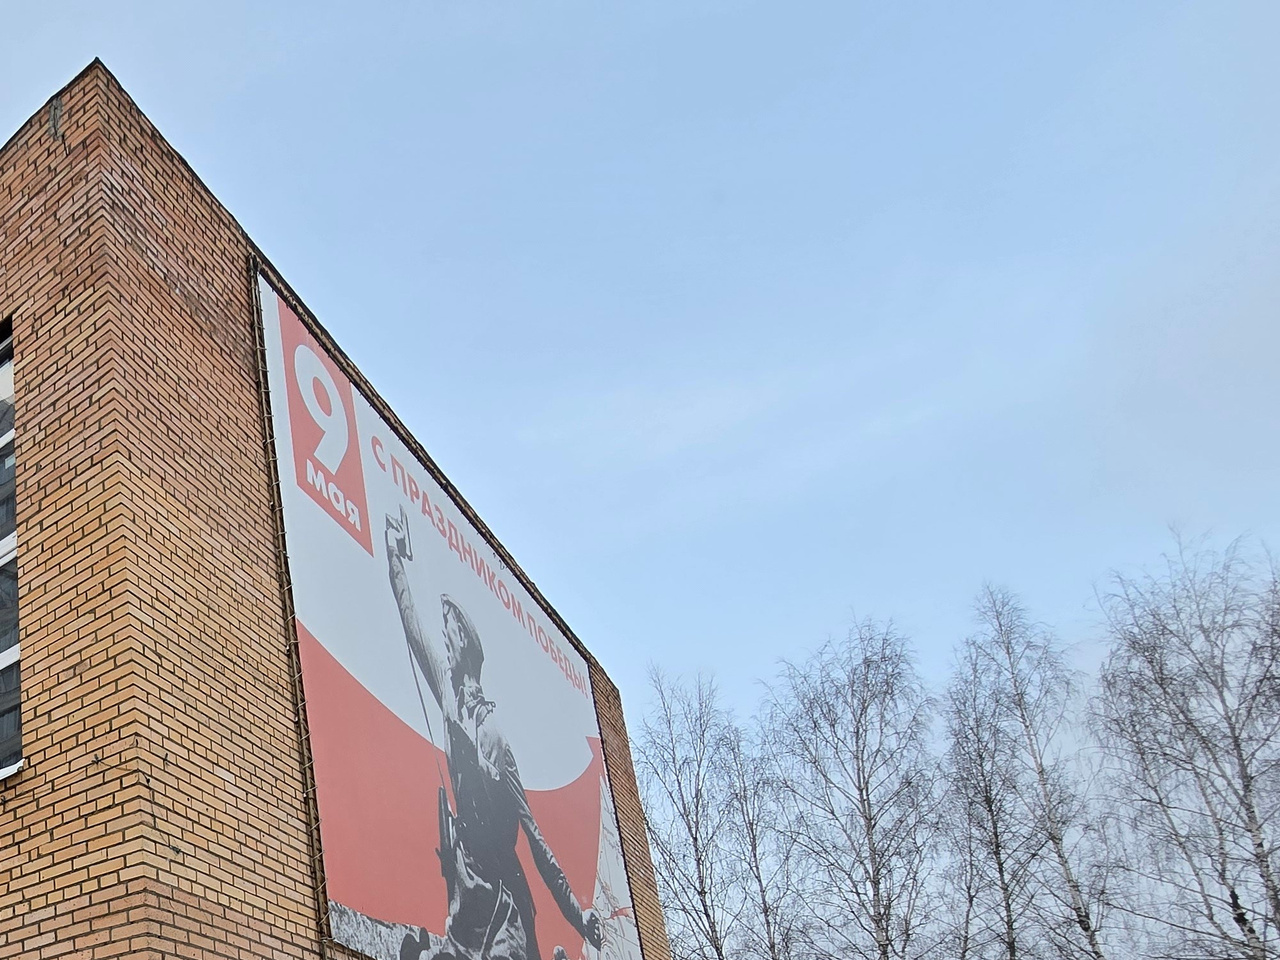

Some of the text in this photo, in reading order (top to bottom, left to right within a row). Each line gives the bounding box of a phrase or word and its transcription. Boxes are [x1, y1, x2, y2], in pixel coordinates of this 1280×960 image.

[294, 344, 349, 476] 9
[306, 458, 362, 532] мая
[371, 435, 588, 699] С ПРАЗДНИКОМ ПОБЕДЫ!
